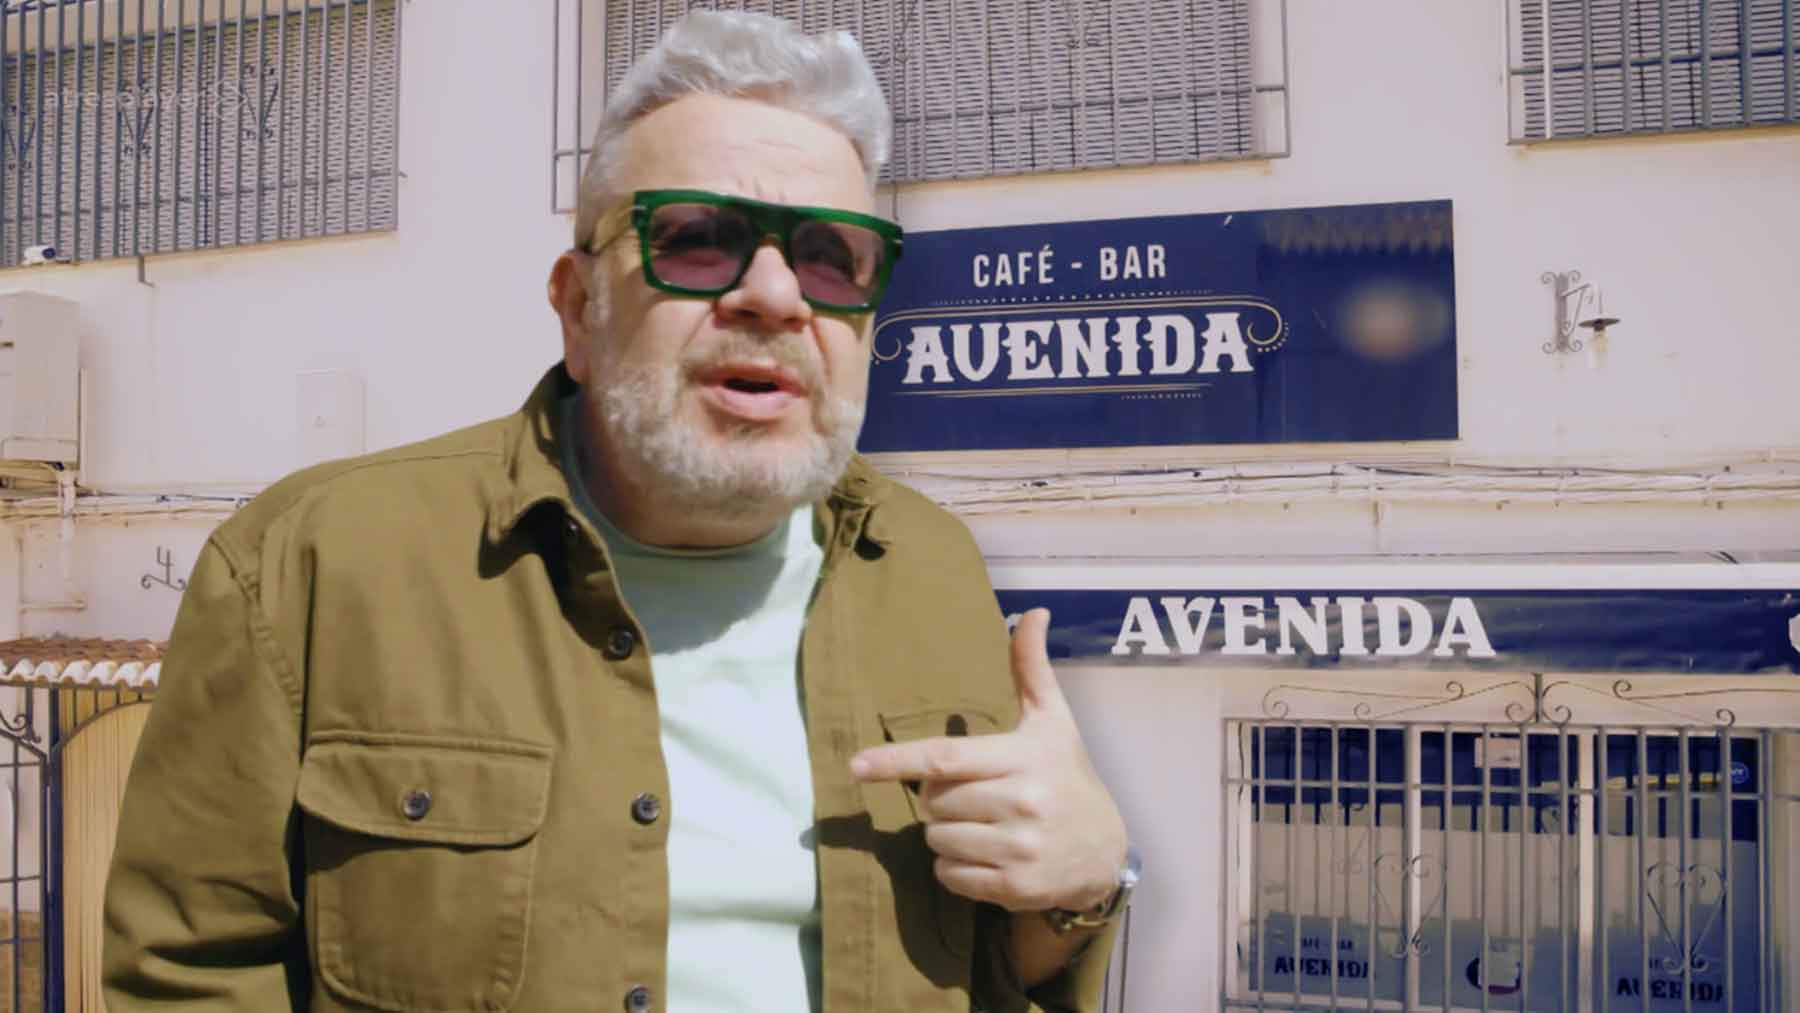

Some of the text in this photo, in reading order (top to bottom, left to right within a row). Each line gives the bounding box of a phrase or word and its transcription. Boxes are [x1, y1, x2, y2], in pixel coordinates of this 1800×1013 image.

[972, 243, 1054, 288] CAFÉ
[1100, 244, 1167, 281] BAR
[1111, 596, 1497, 658] AVENIDA
